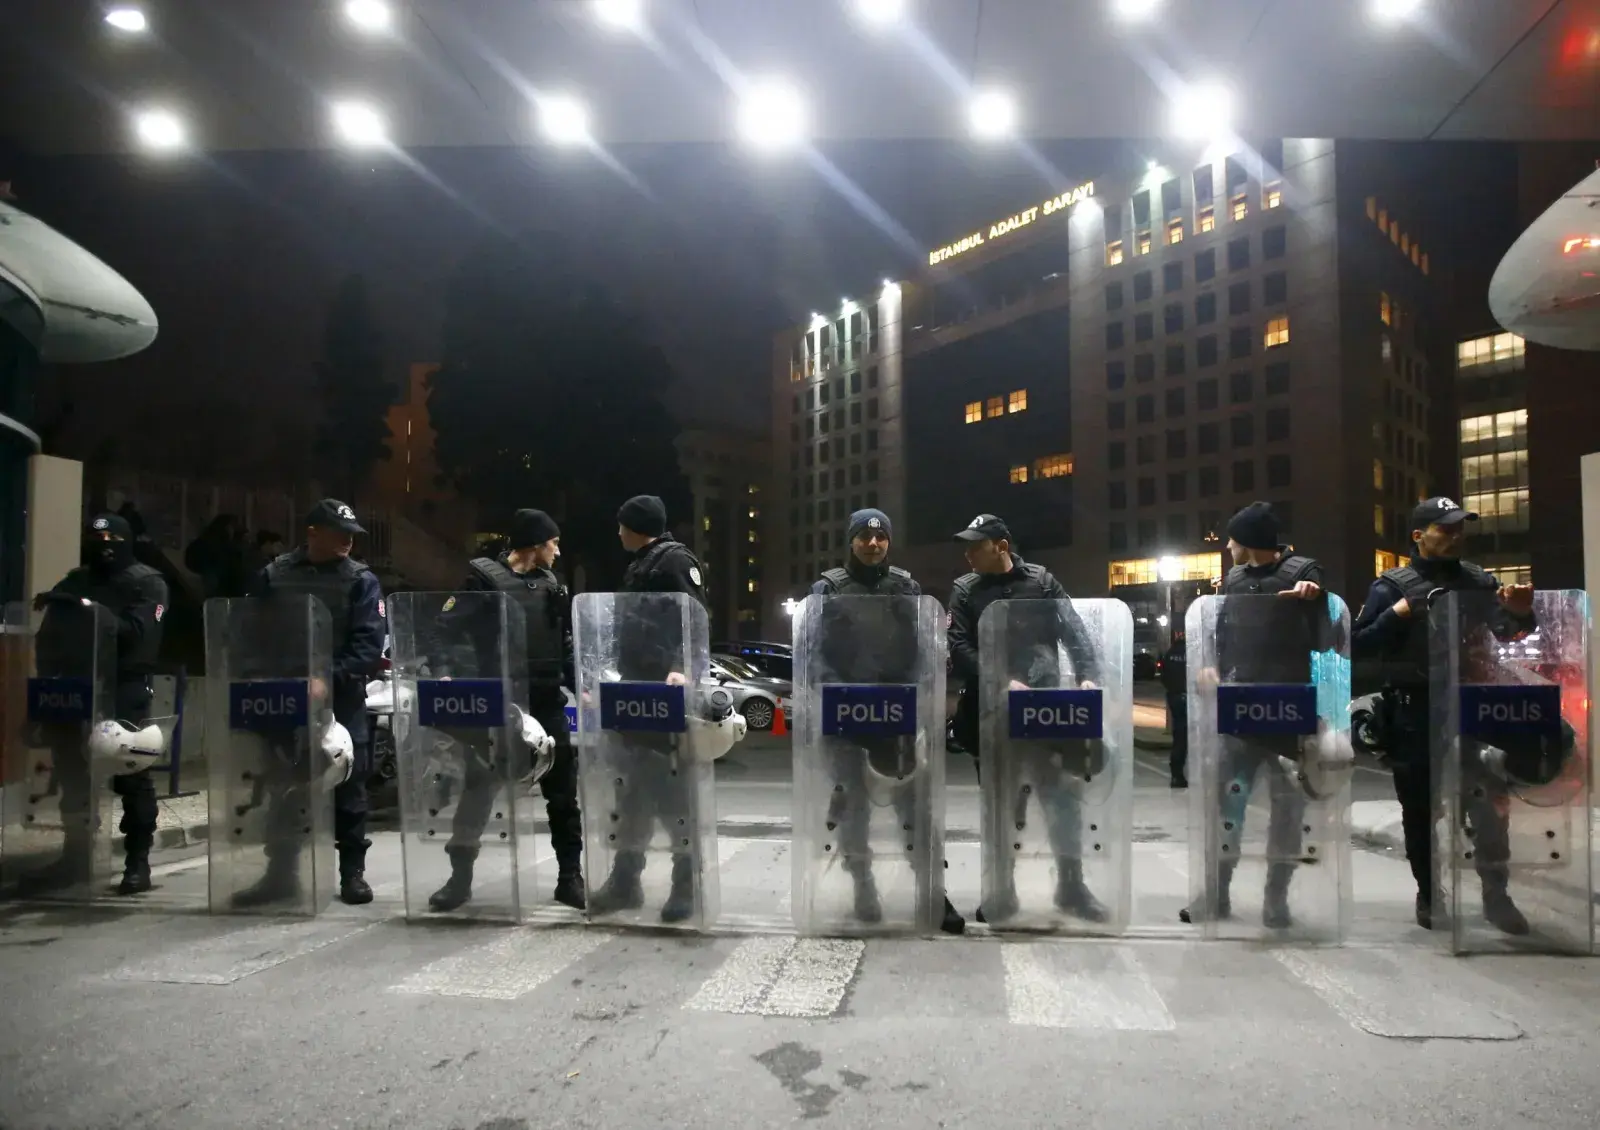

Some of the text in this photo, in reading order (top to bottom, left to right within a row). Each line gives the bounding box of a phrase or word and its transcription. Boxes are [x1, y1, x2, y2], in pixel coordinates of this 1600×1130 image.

[929, 181, 1095, 265] İSTANBUL ADALET SARAYI
[433, 693, 489, 715] POLİS
[615, 698, 669, 719] POLİS
[837, 700, 904, 722] POLİS
[1023, 703, 1089, 726] POLİS
[1478, 700, 1542, 721] POLİS
